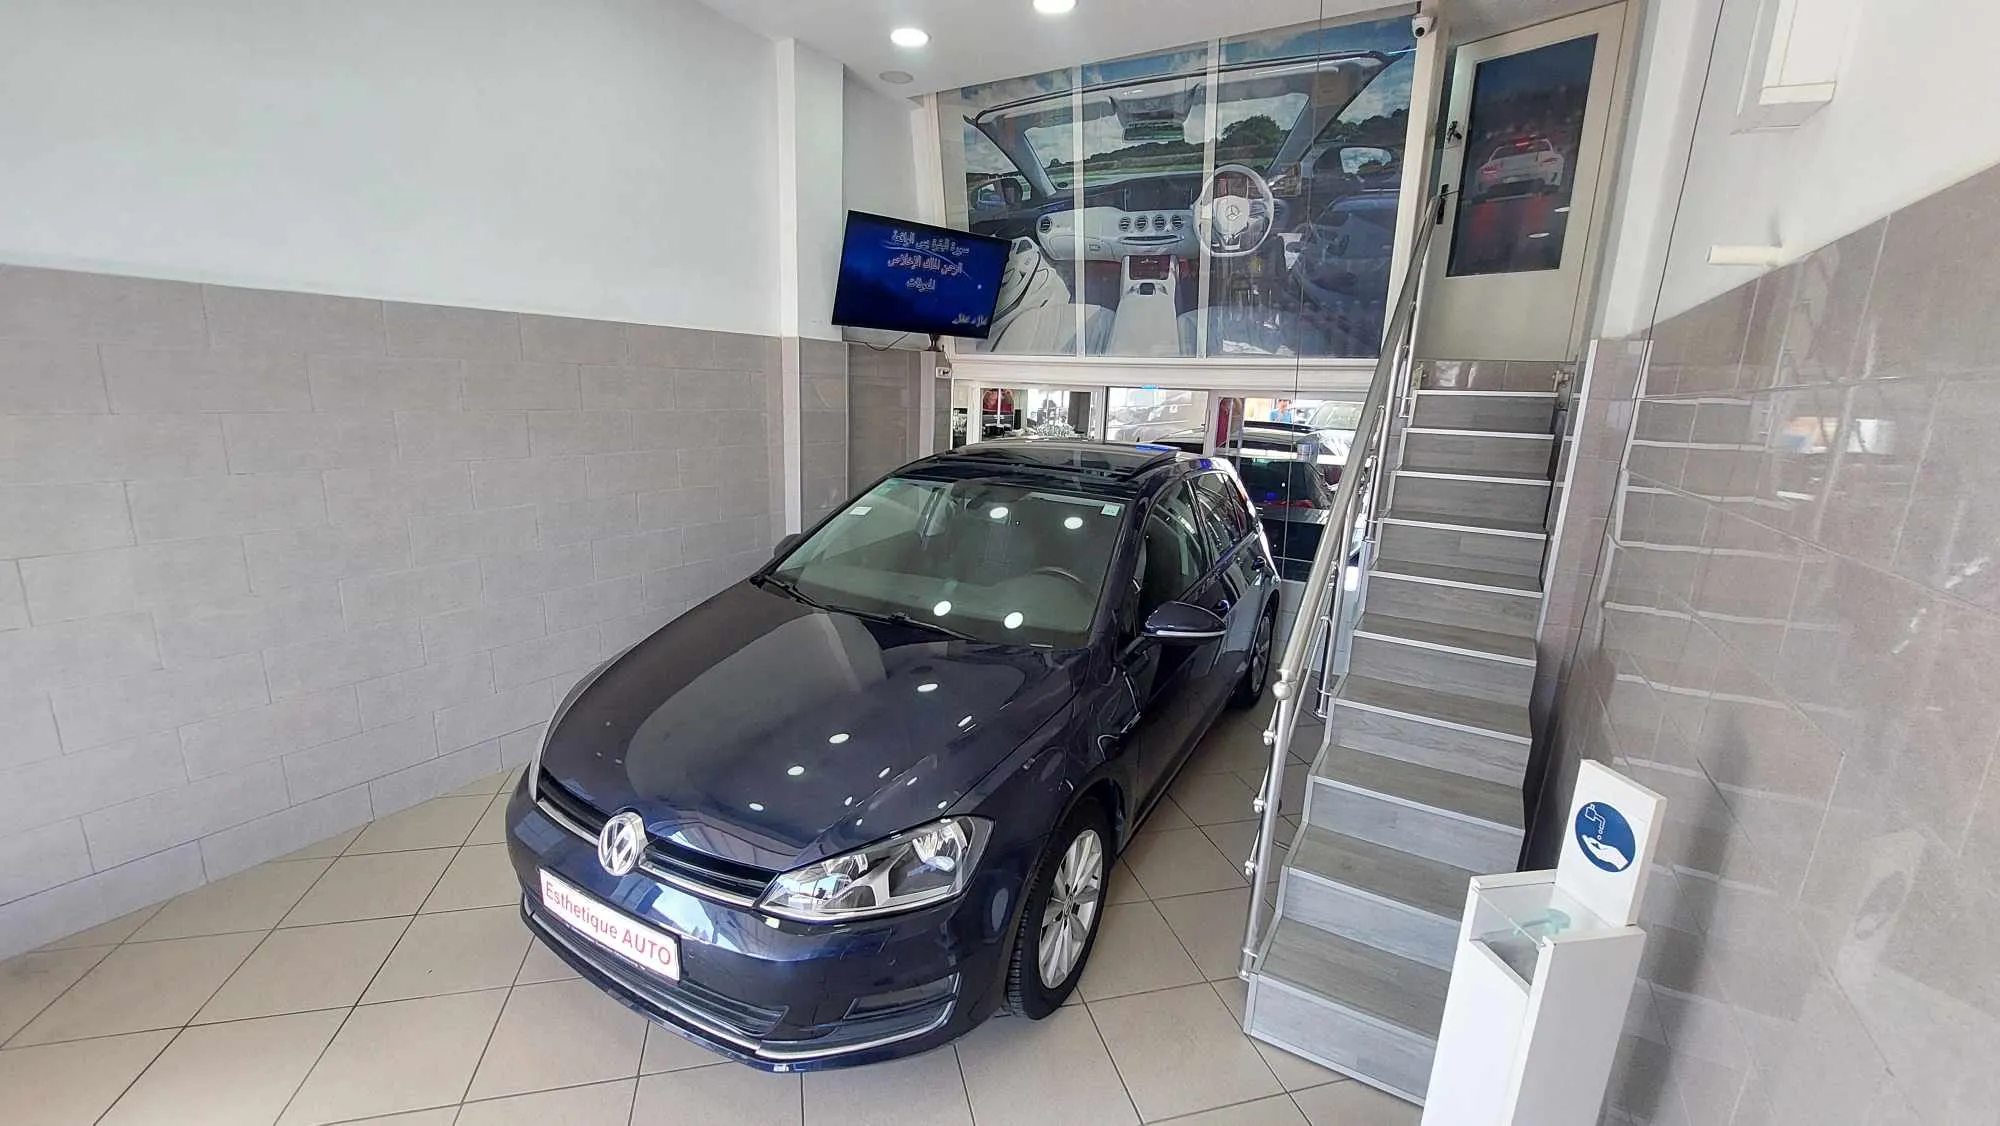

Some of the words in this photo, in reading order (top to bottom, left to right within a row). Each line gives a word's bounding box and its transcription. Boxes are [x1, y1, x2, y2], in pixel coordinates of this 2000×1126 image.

[931, 238, 950, 252] البقرة
[950, 242, 970, 256] سورة
[923, 256, 941, 271] الملك
[941, 262, 963, 276] الرحمن
[545, 880, 618, 940] Esthetique
[622, 929, 672, 966] AUTO
